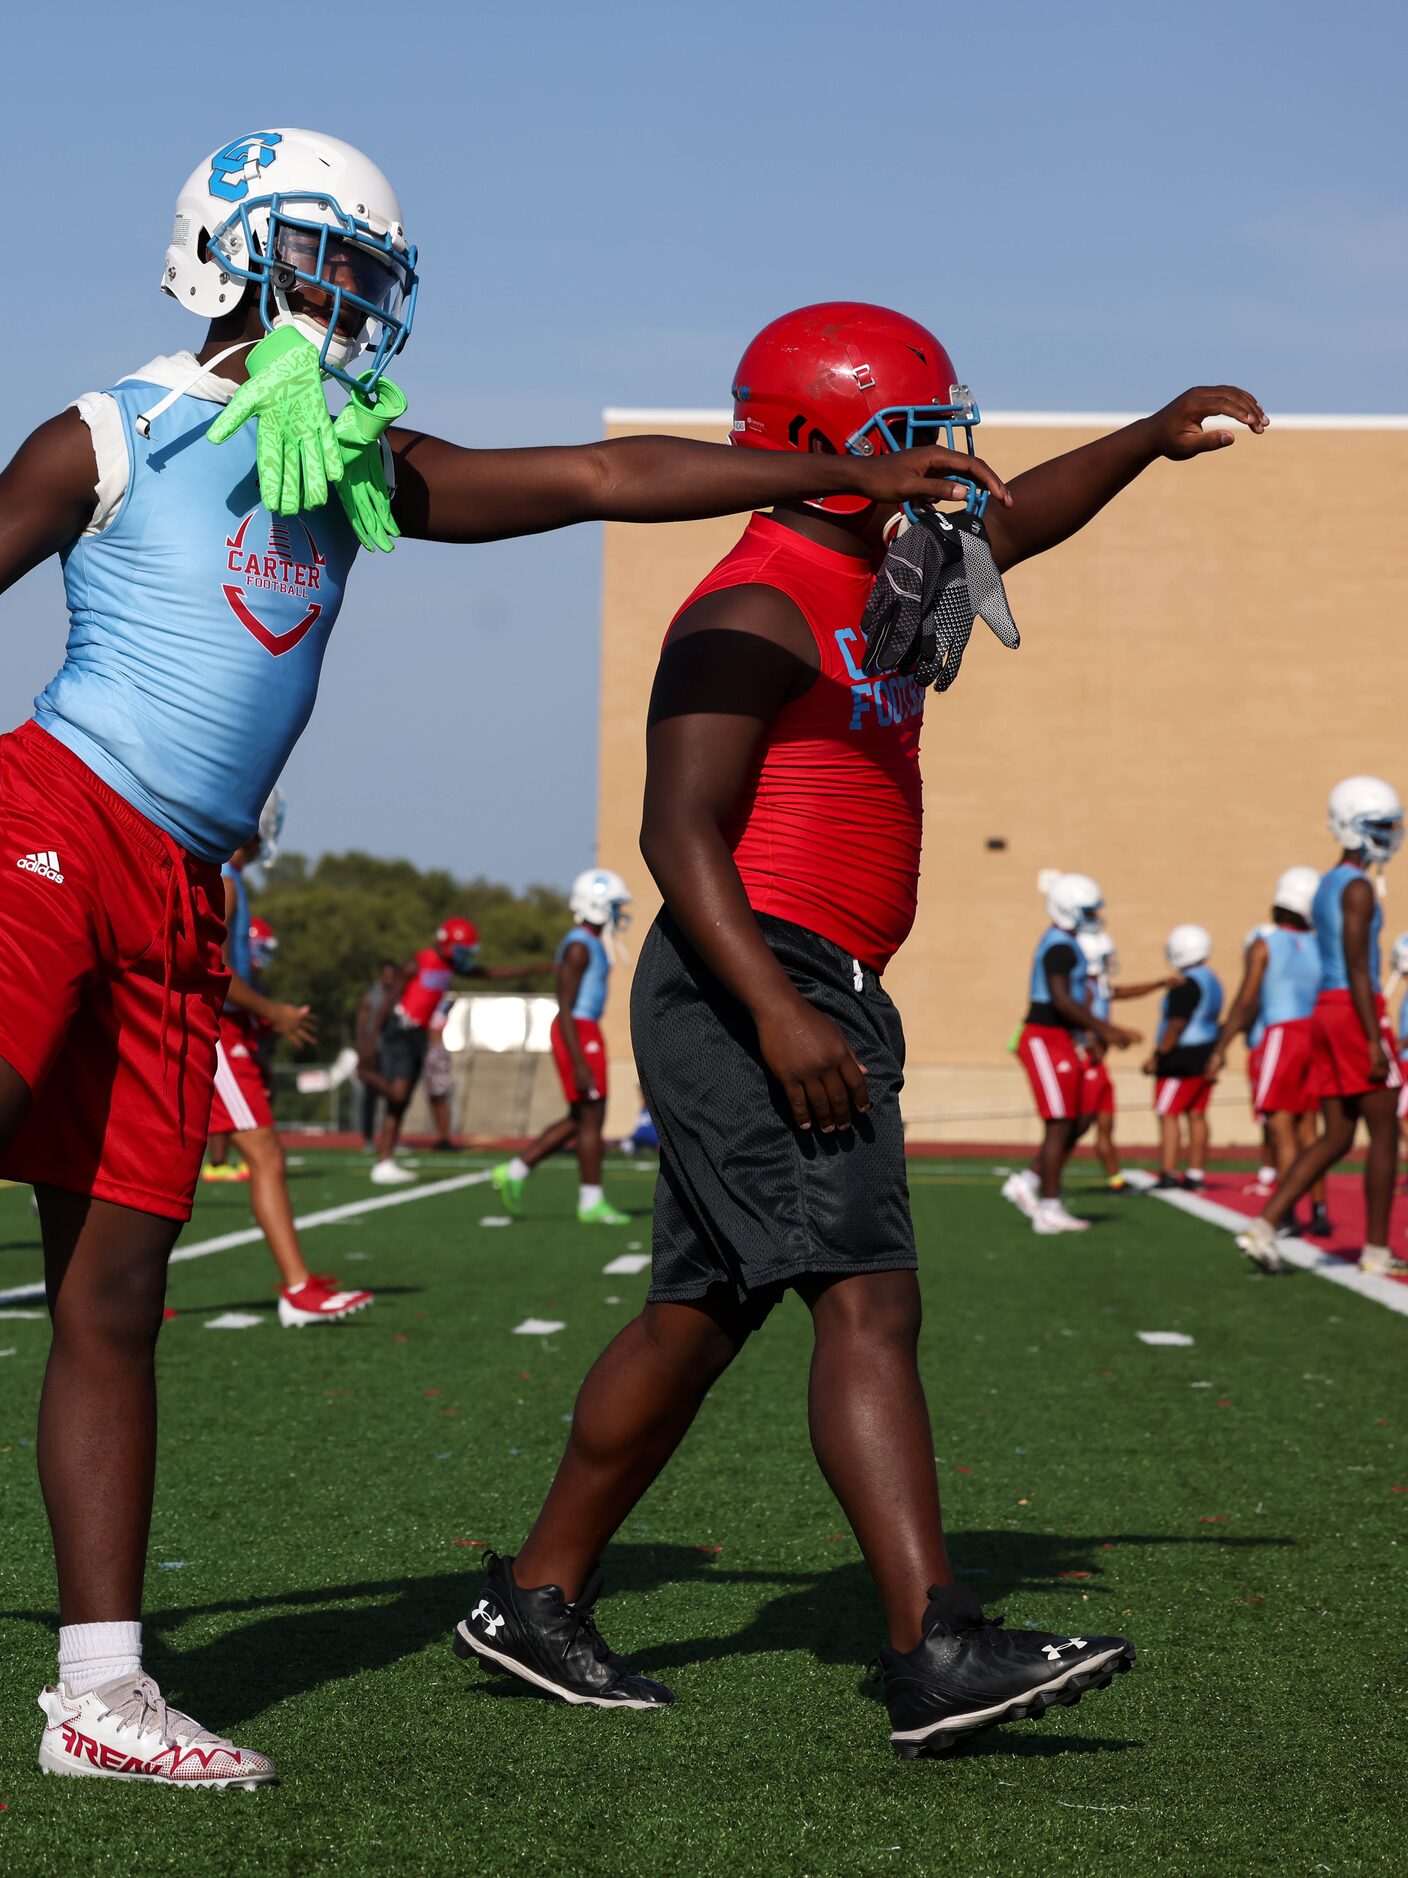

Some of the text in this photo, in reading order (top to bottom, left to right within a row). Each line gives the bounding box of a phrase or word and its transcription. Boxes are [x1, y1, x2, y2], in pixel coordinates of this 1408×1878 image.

[227, 549, 321, 590] CARTER
[245, 575, 309, 599] FOOTBALL
[16, 858, 65, 884] adidas
